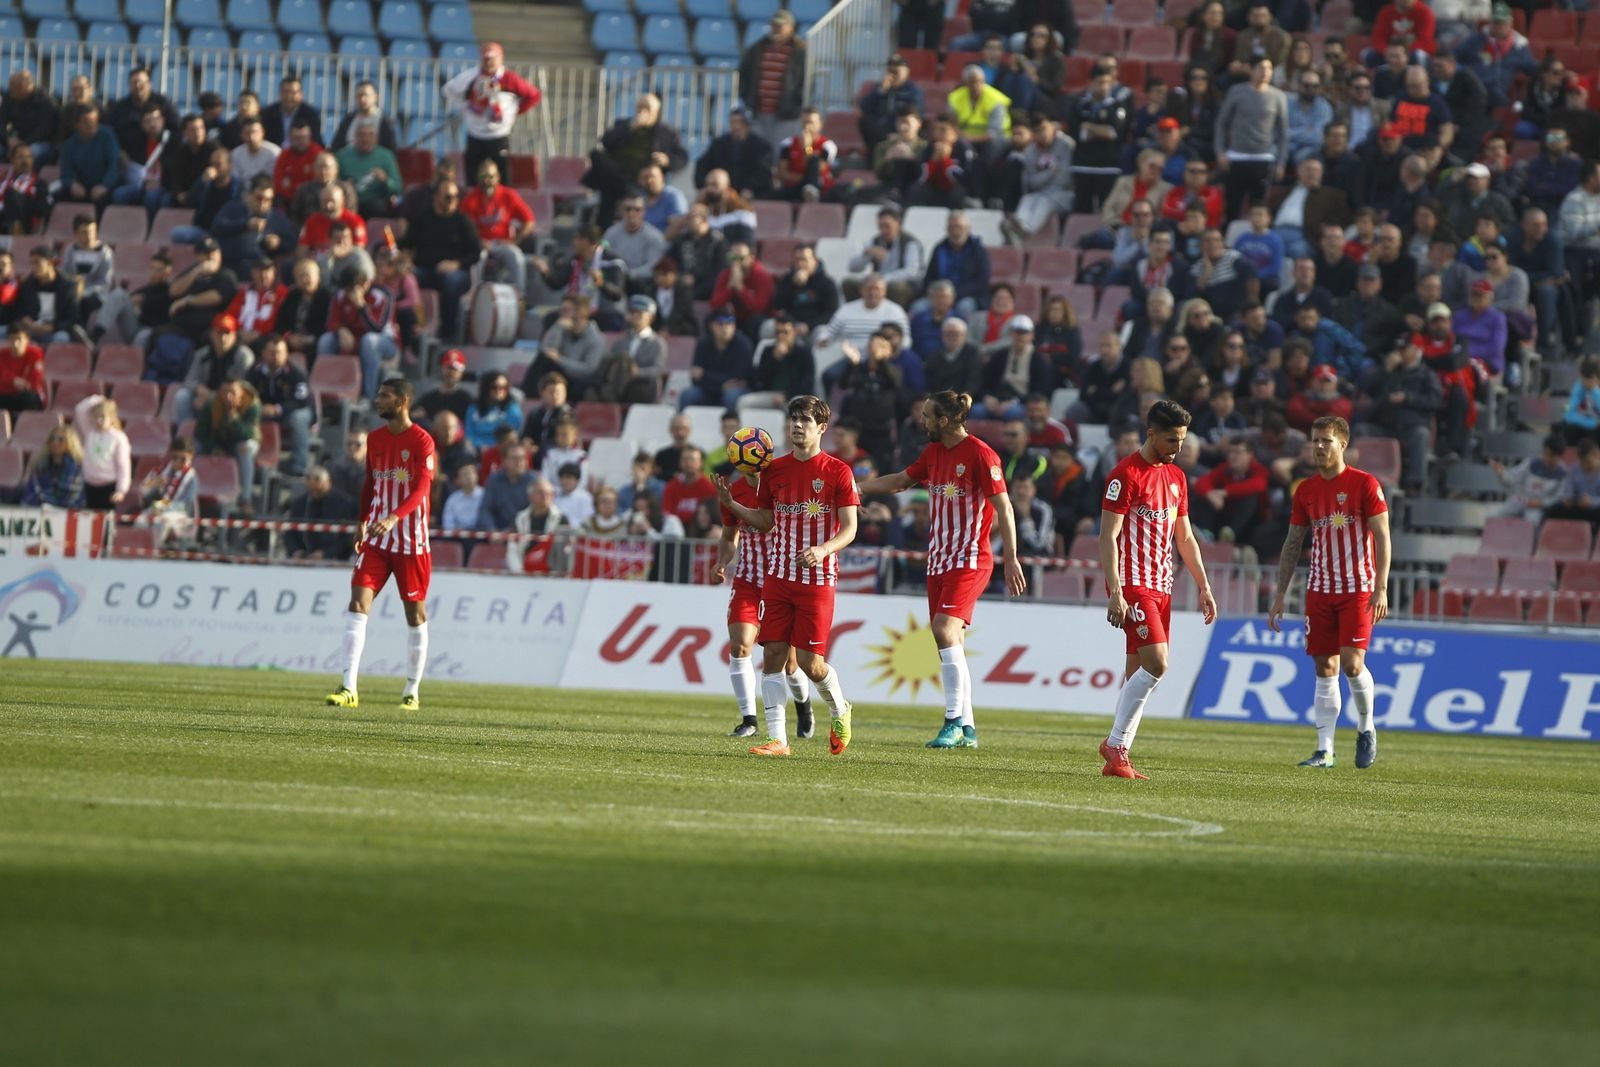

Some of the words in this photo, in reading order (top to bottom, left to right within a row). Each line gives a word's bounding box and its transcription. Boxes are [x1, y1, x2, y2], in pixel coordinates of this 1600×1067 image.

[343, 591, 566, 626] LERÍA
[1230, 620, 1437, 657] Autres
[983, 644, 1126, 690] L.co
[1203, 651, 1532, 734] Rdel
